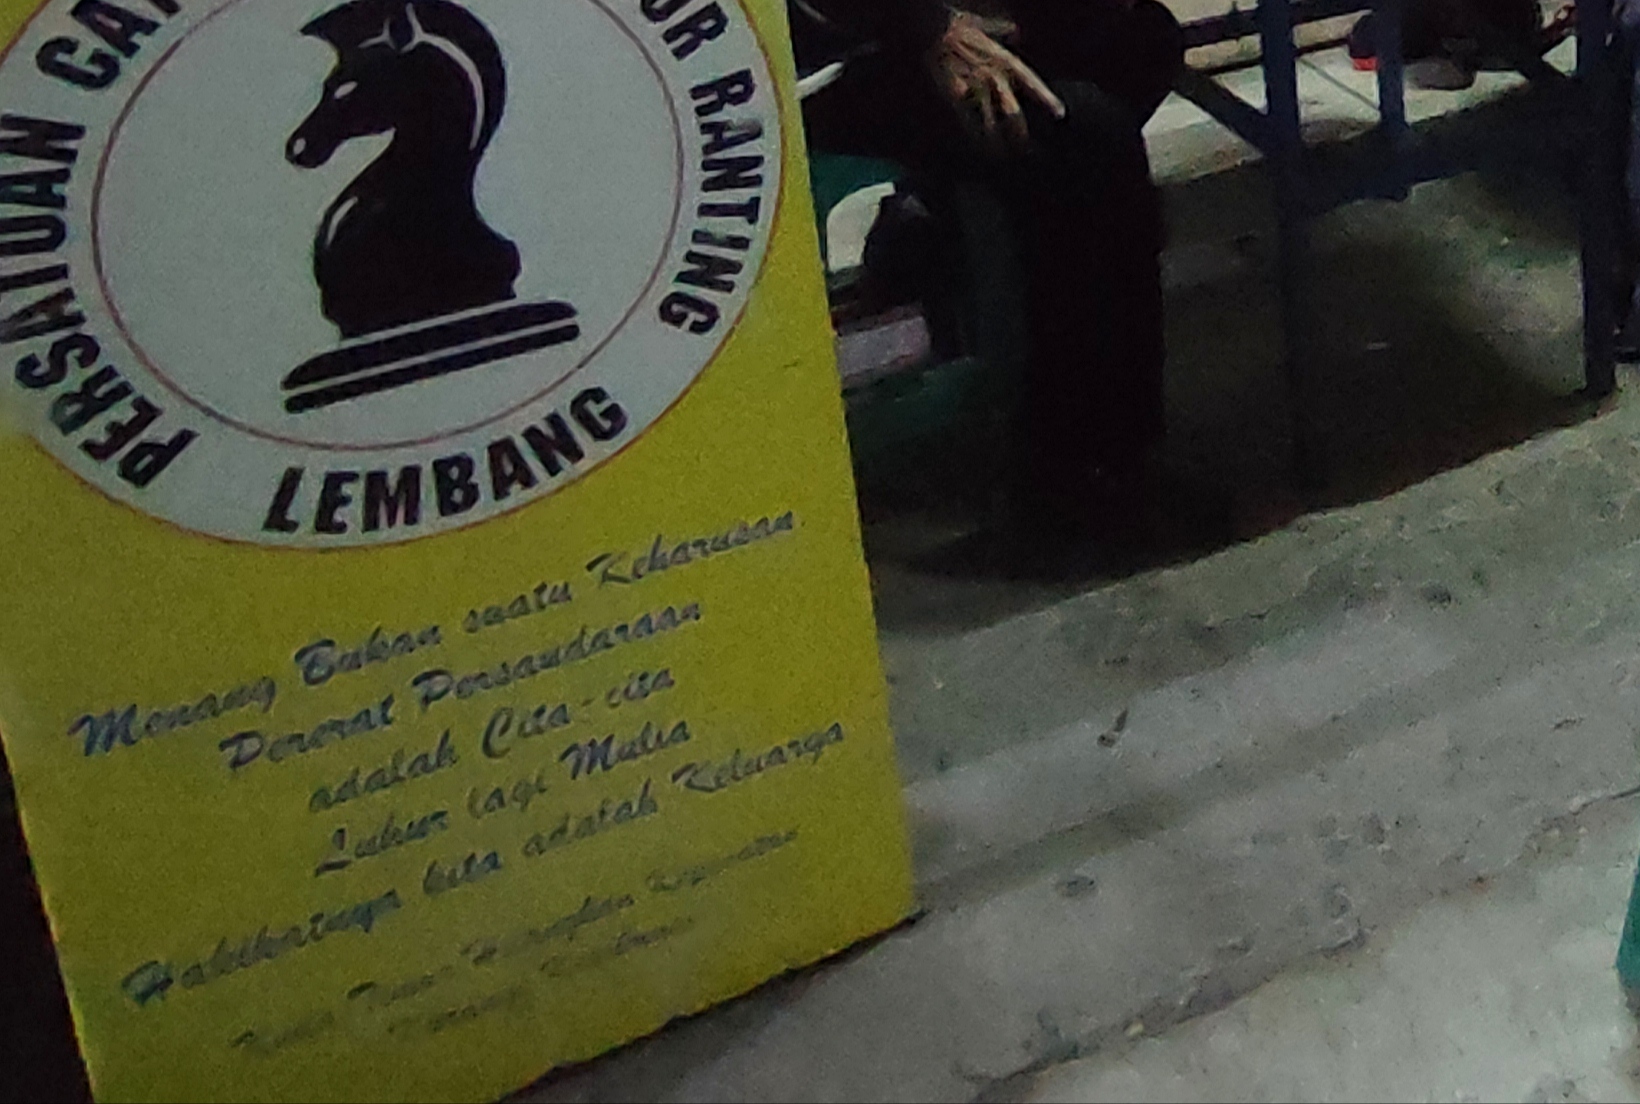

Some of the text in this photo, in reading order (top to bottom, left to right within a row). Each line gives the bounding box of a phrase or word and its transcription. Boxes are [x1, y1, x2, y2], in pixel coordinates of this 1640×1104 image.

[659, 68, 766, 335] RANTING
[263, 386, 628, 534] LEMBANG
[309, 729, 460, 813] adalah
